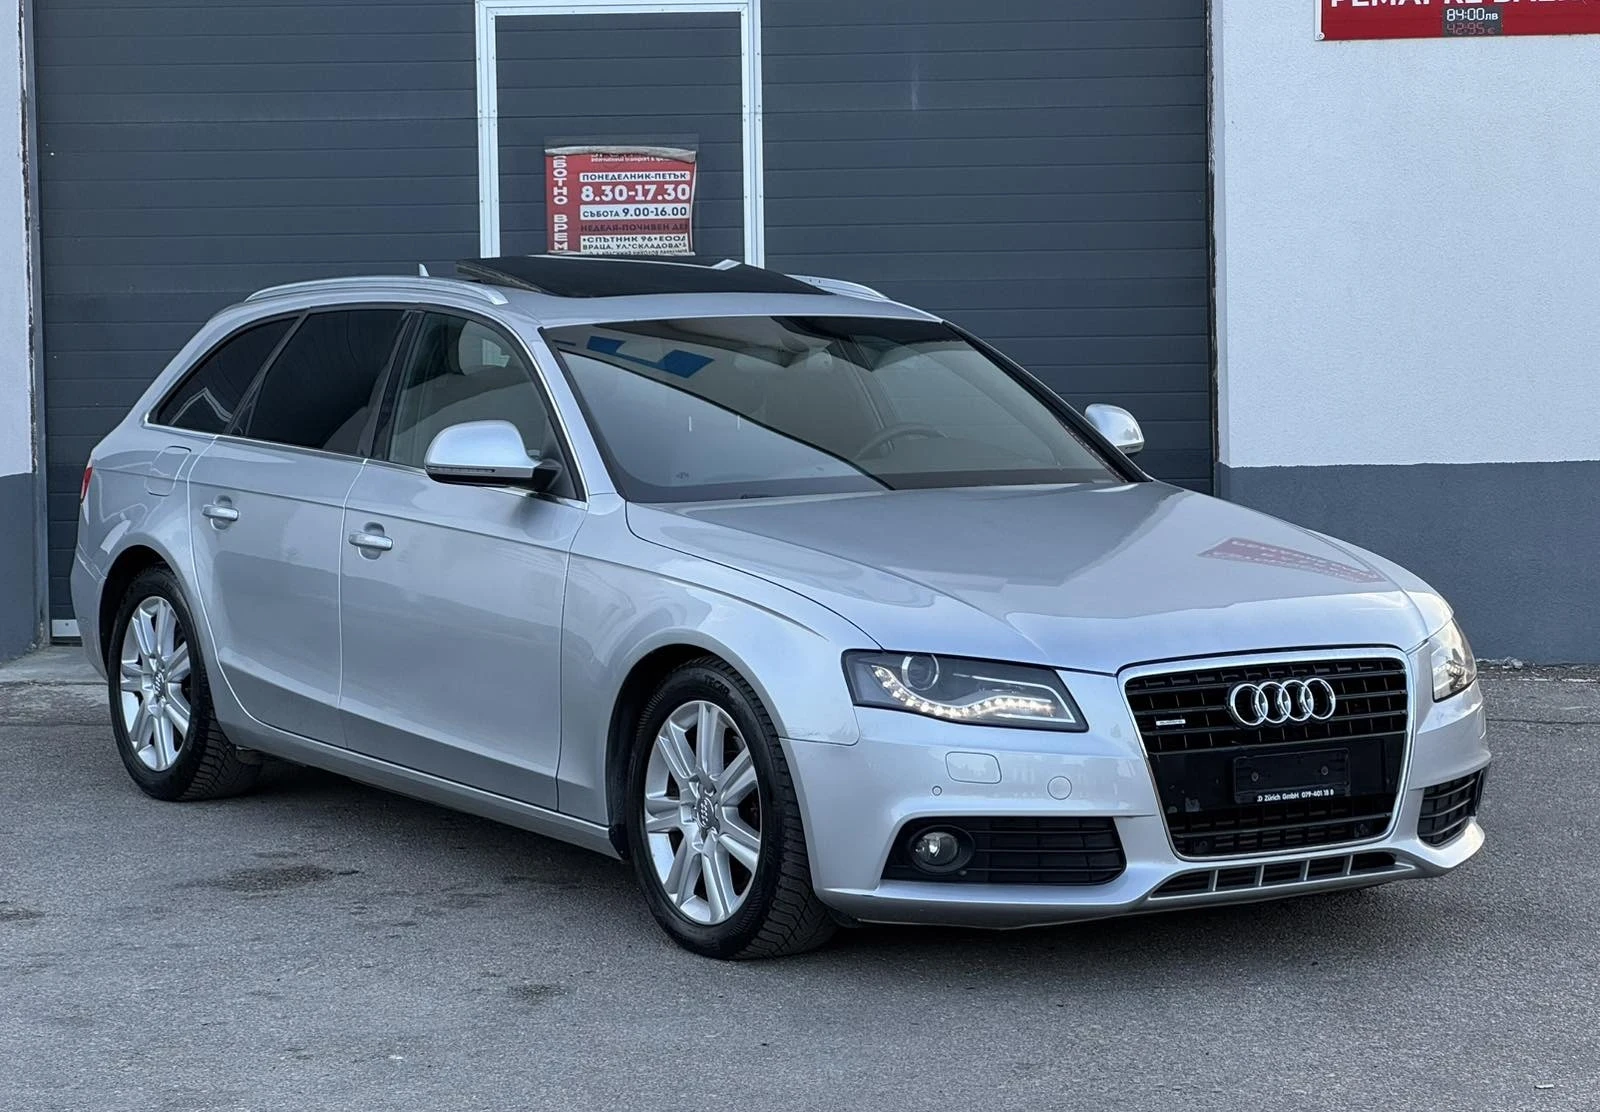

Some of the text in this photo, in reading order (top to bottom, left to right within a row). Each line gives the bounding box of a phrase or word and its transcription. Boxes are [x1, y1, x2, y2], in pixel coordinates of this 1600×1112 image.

[582, 173, 686, 181] ПОНЕДЕЛНИК-ПЕТЪК
[581, 184, 690, 201] 8.30-17.30
[583, 207, 687, 218] СЪБОТА 9.00-16.00
[1282, 792, 1300, 800] GmbH
